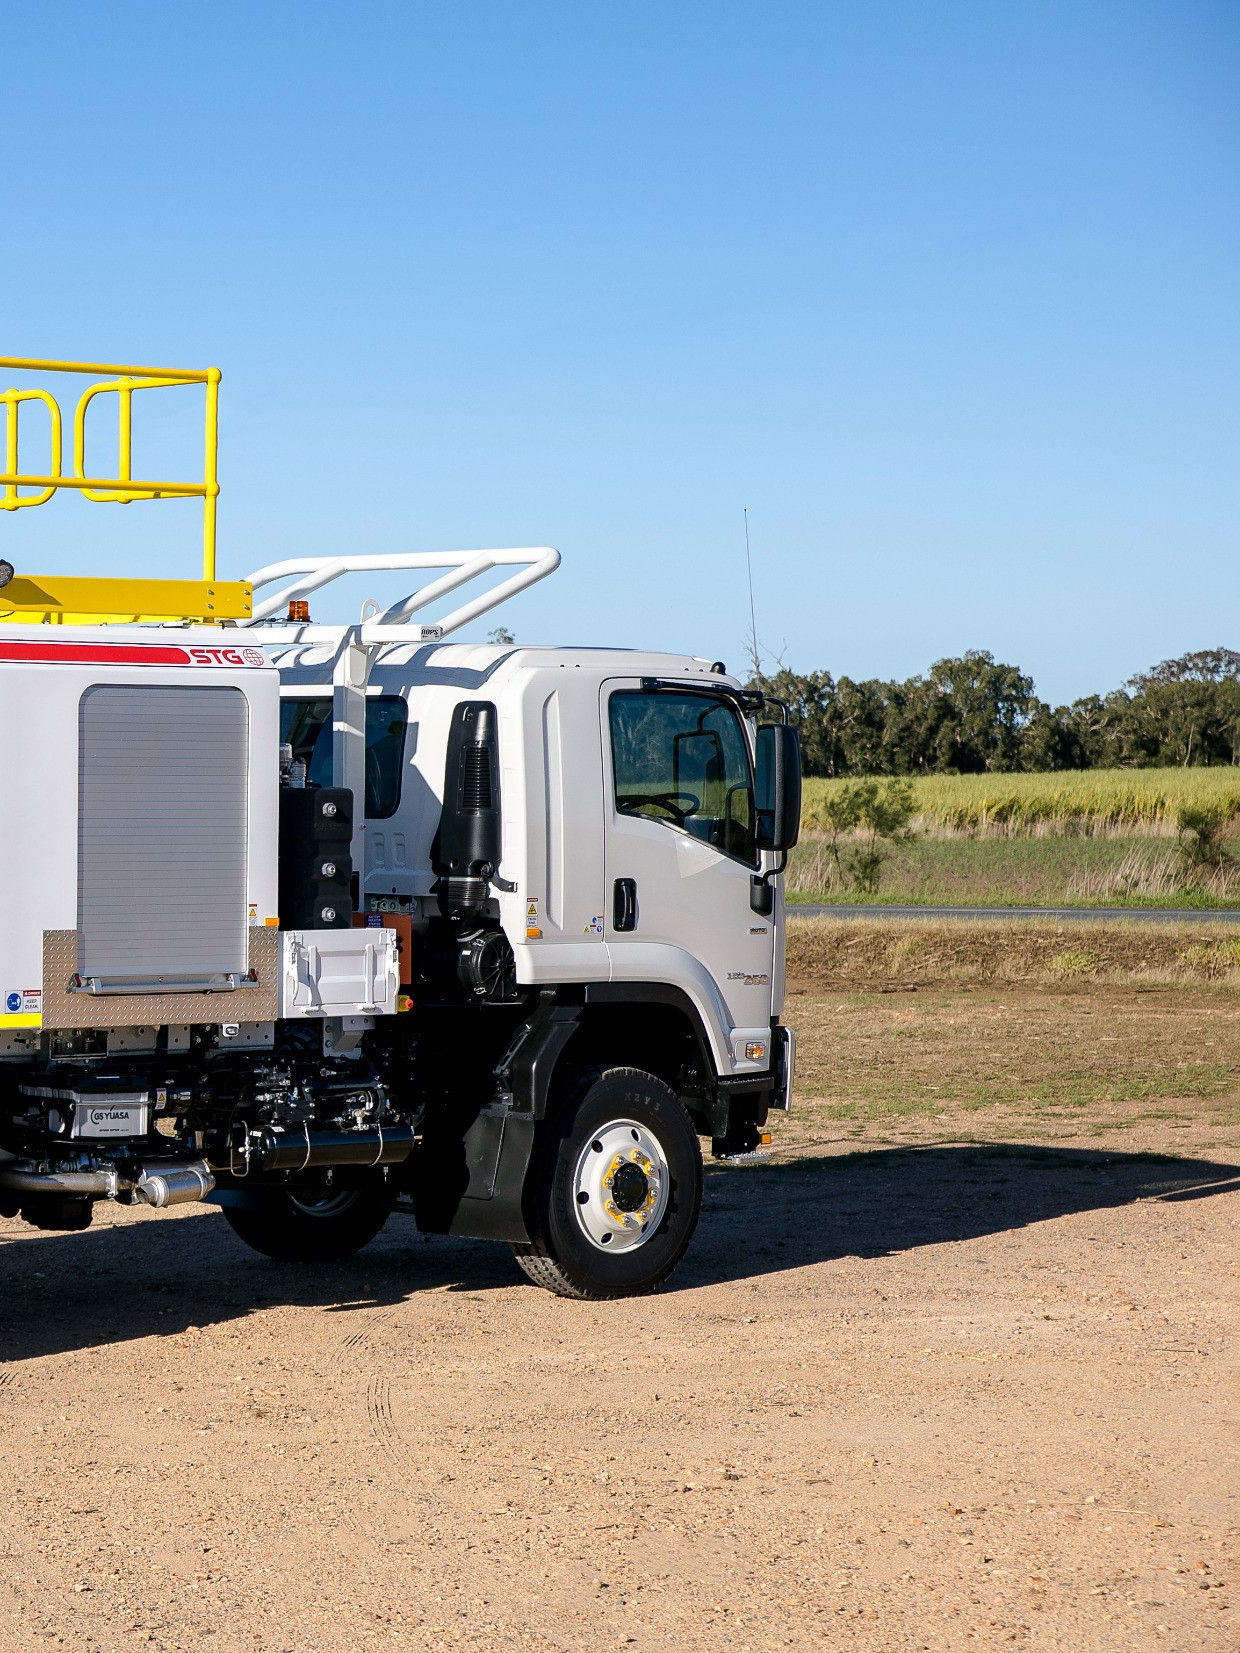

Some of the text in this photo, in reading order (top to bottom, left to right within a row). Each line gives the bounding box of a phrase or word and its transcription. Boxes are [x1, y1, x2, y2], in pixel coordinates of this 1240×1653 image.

[189, 648, 245, 665] STG
[94, 1109, 130, 1121] GS YUASA
